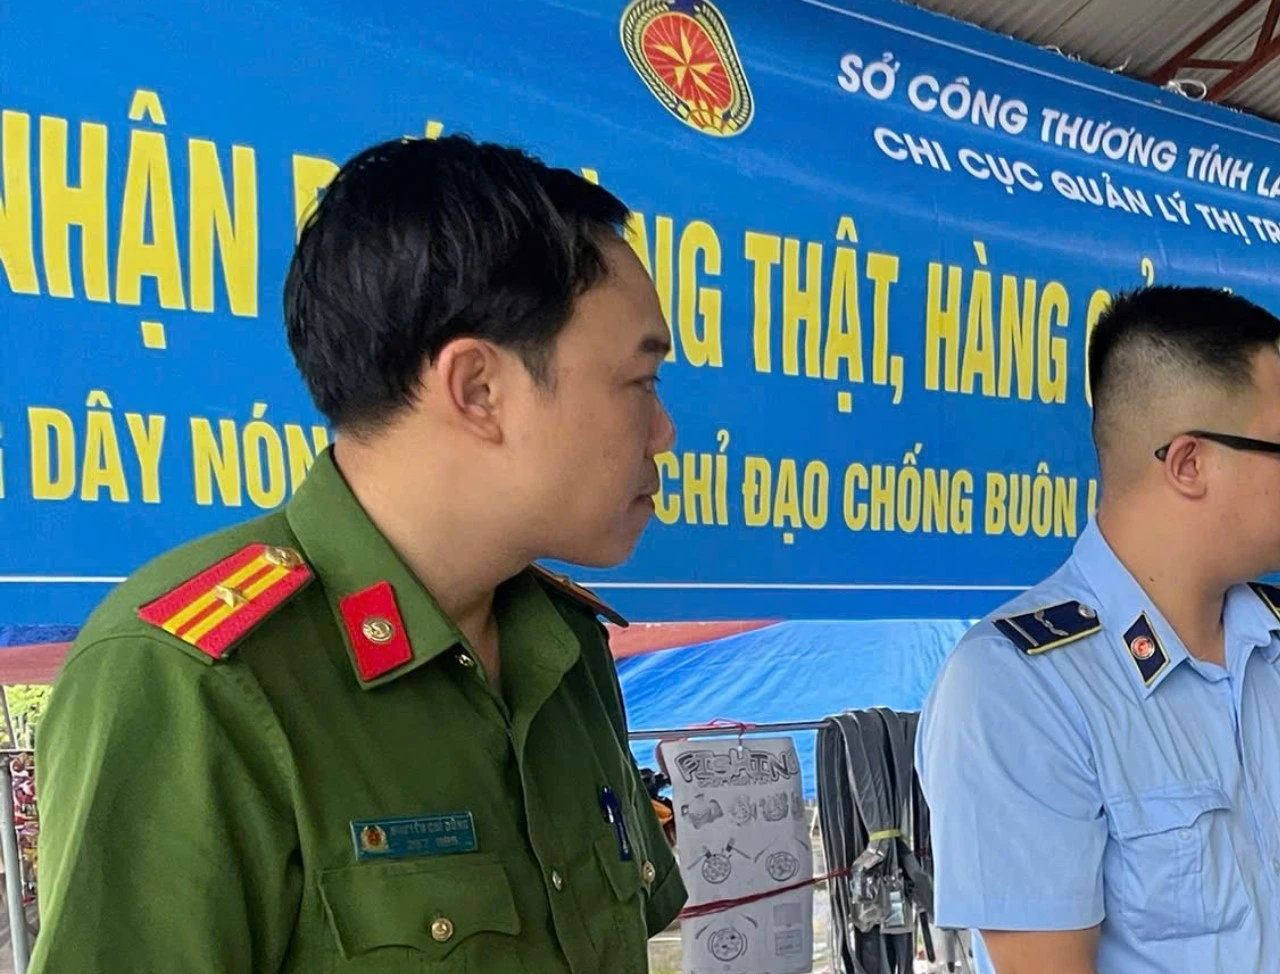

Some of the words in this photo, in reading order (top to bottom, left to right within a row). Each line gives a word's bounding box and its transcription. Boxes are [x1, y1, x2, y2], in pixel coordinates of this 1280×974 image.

[837, 53, 902, 100] SỞ
[908, 76, 1028, 134] CÔNG
[1040, 108, 1178, 173] THƯƠNG
[873, 126, 951, 172] CHI
[957, 148, 1044, 194] CỤC
[1050, 173, 1151, 218] QUẢN
[1154, 191, 1191, 225] LÝ
[1194, 203, 1251, 246] THỊ
[745, 217, 904, 413] THẬT,
[925, 241, 1068, 404] HÀNG
[30, 390, 167, 503] DÂY
[653, 430, 729, 525] CHỈ
[742, 455, 828, 544] ĐẠO
[844, 443, 974, 534] CHỐNG
[985, 464, 1078, 538] BUÔN
